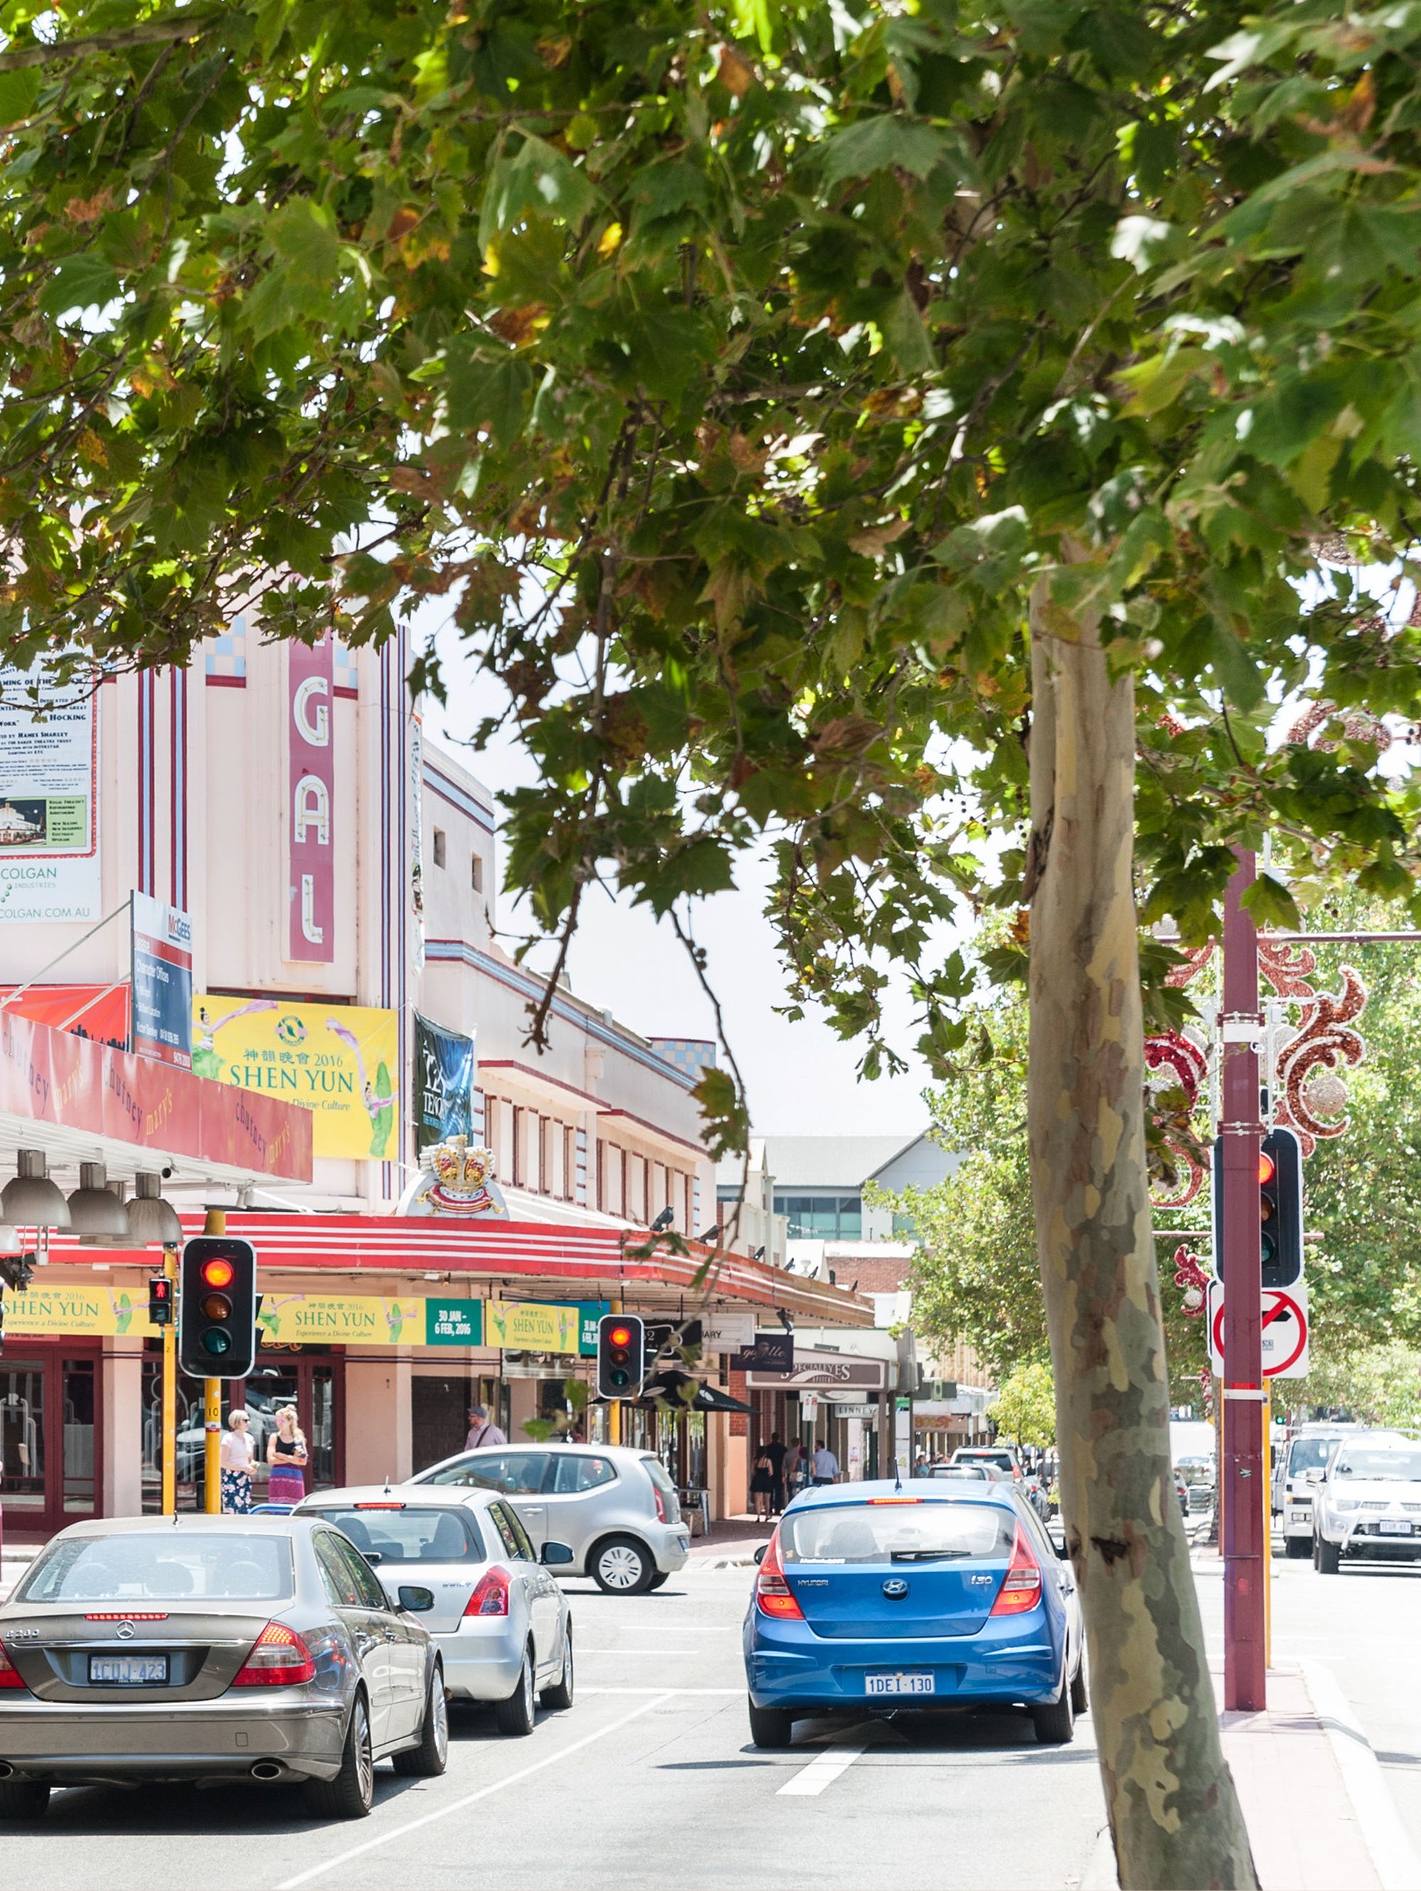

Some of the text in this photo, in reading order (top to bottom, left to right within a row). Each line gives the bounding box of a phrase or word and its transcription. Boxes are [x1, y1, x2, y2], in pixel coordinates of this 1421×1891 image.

[293, 642, 330, 944] GAL
[0, 867, 57, 879] COLGAN
[314, 1053, 343, 1067] 2016
[230, 1064, 354, 1094] SHEN YUN
[104, 1054, 173, 1140] chutney mary's
[321, 1100, 351, 1111] Culture
[235, 1092, 267, 1167] chutney
[2, 1300, 99, 1317] SHEN YUN
[294, 1311, 376, 1329] SHEN YUN
[438, 1310, 448, 1322] 30
[448, 1310, 462, 1322] JAN
[434, 1323, 440, 1335] 6
[455, 1323, 472, 1336] 2016
[513, 1318, 554, 1334] SHEN YUN
[207, 1408, 219, 1417] 10
[914, 1417, 953, 1429] BOOST
[797, 1579, 829, 1587] HYUNDAI
